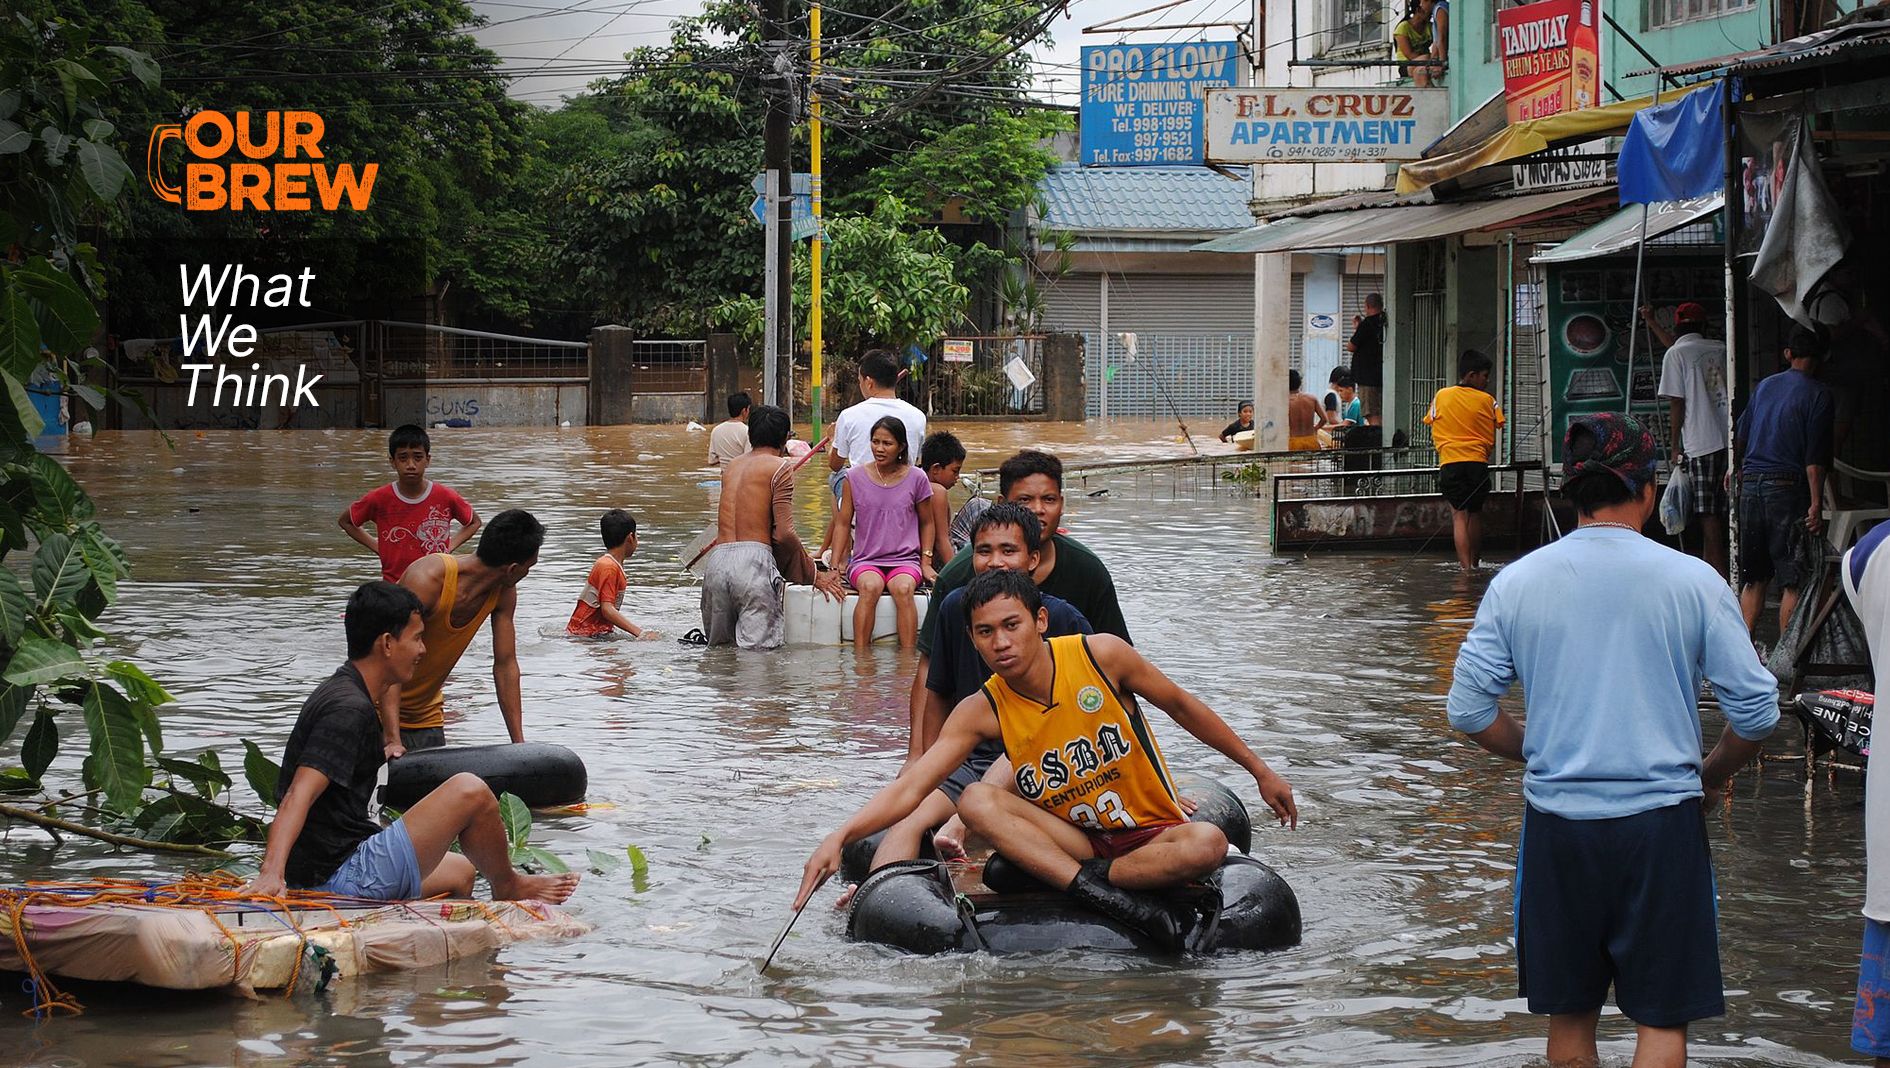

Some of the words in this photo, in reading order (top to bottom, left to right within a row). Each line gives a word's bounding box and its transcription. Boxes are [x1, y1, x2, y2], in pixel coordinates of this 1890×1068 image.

[1502, 14, 1569, 56] TANDUAY
[1089, 48, 1144, 81] PRO
[1152, 45, 1228, 79] FLOW
[1506, 56, 1532, 78] RHUM
[1533, 54, 1539, 75] 5
[1540, 48, 1570, 72] YEARS
[1088, 83, 1124, 103] PURE
[1129, 81, 1186, 101] DRINKING
[1115, 103, 1135, 117] WE
[1143, 101, 1197, 116] DELIVER:
[1306, 94, 1415, 118] CRUZ
[1230, 120, 1416, 145] APARTMENT
[1093, 150, 1110, 163] Tel.
[1042, 768, 1121, 808] CENTURIONS
